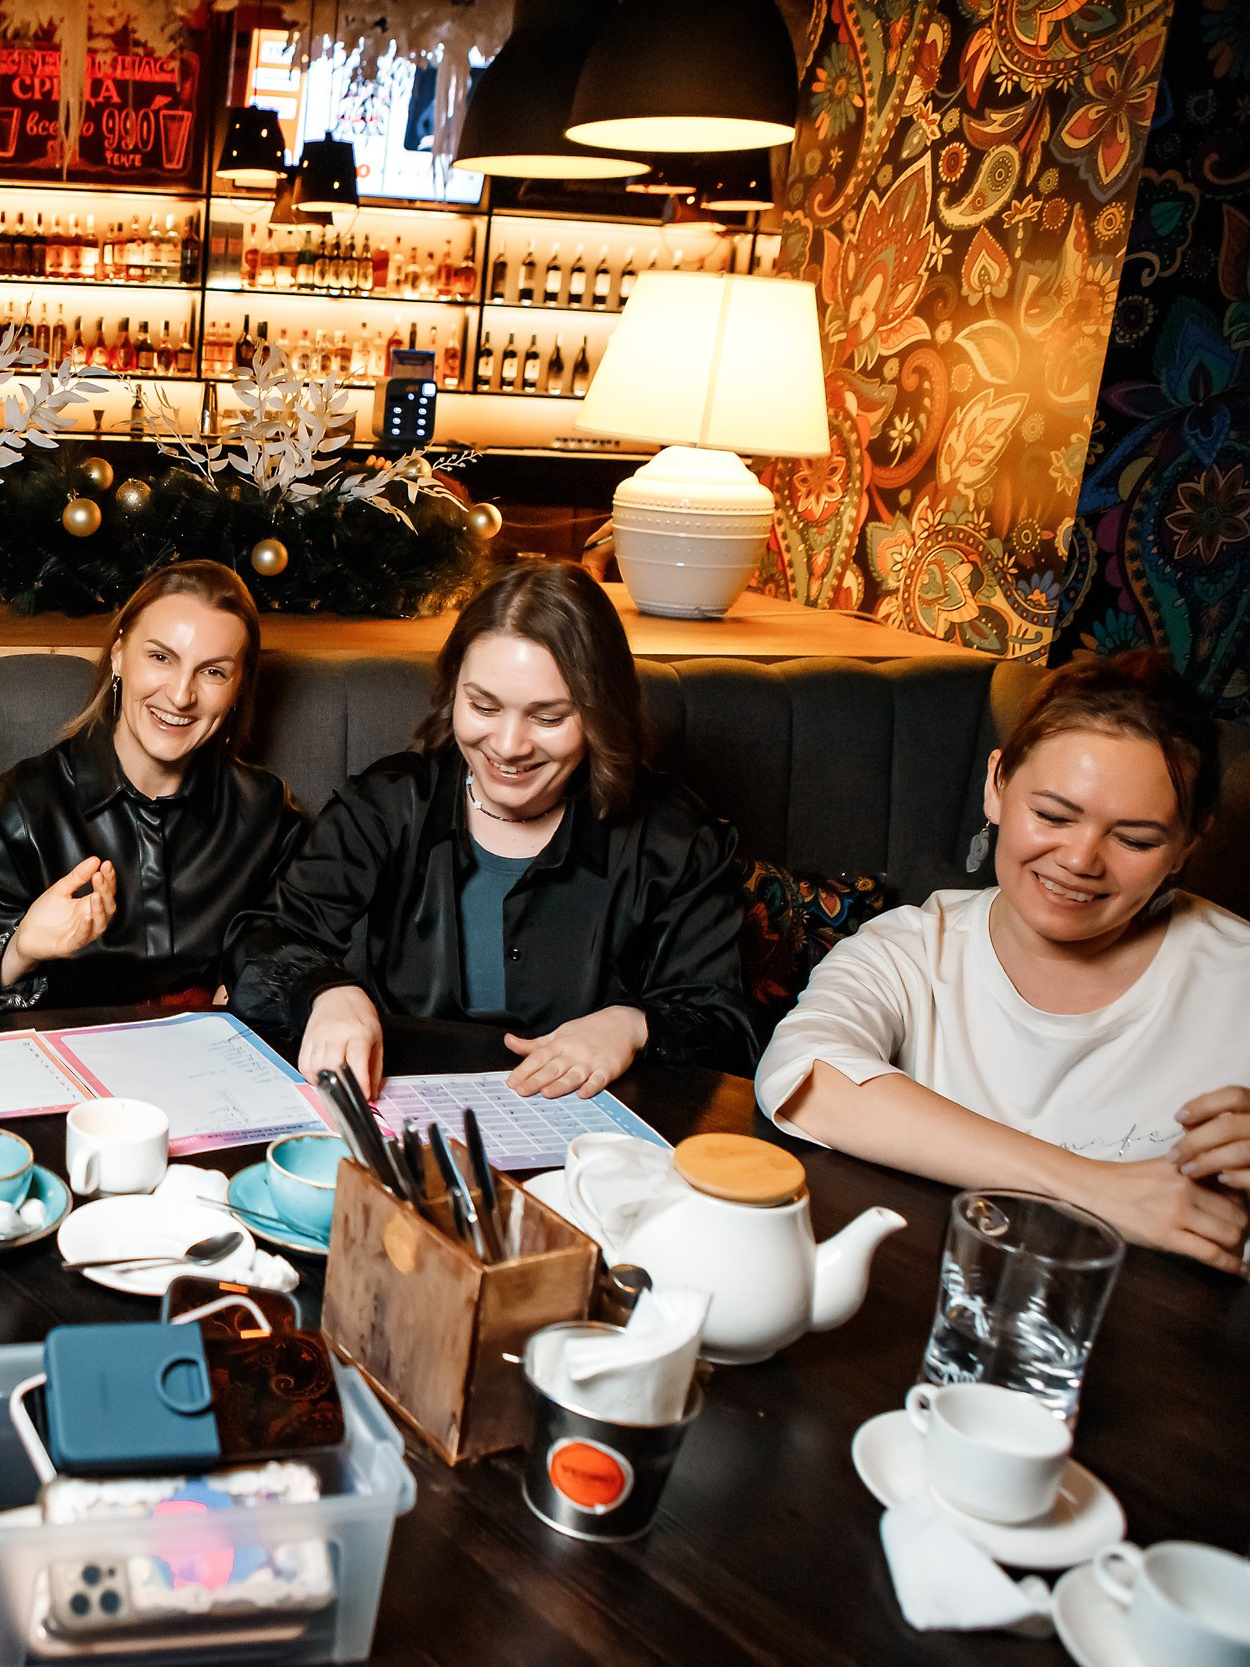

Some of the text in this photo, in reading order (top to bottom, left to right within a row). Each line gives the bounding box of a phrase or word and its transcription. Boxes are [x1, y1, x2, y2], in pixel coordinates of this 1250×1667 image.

[11, 76, 122, 108] СРА
[26, 107, 155, 152] всео 990
